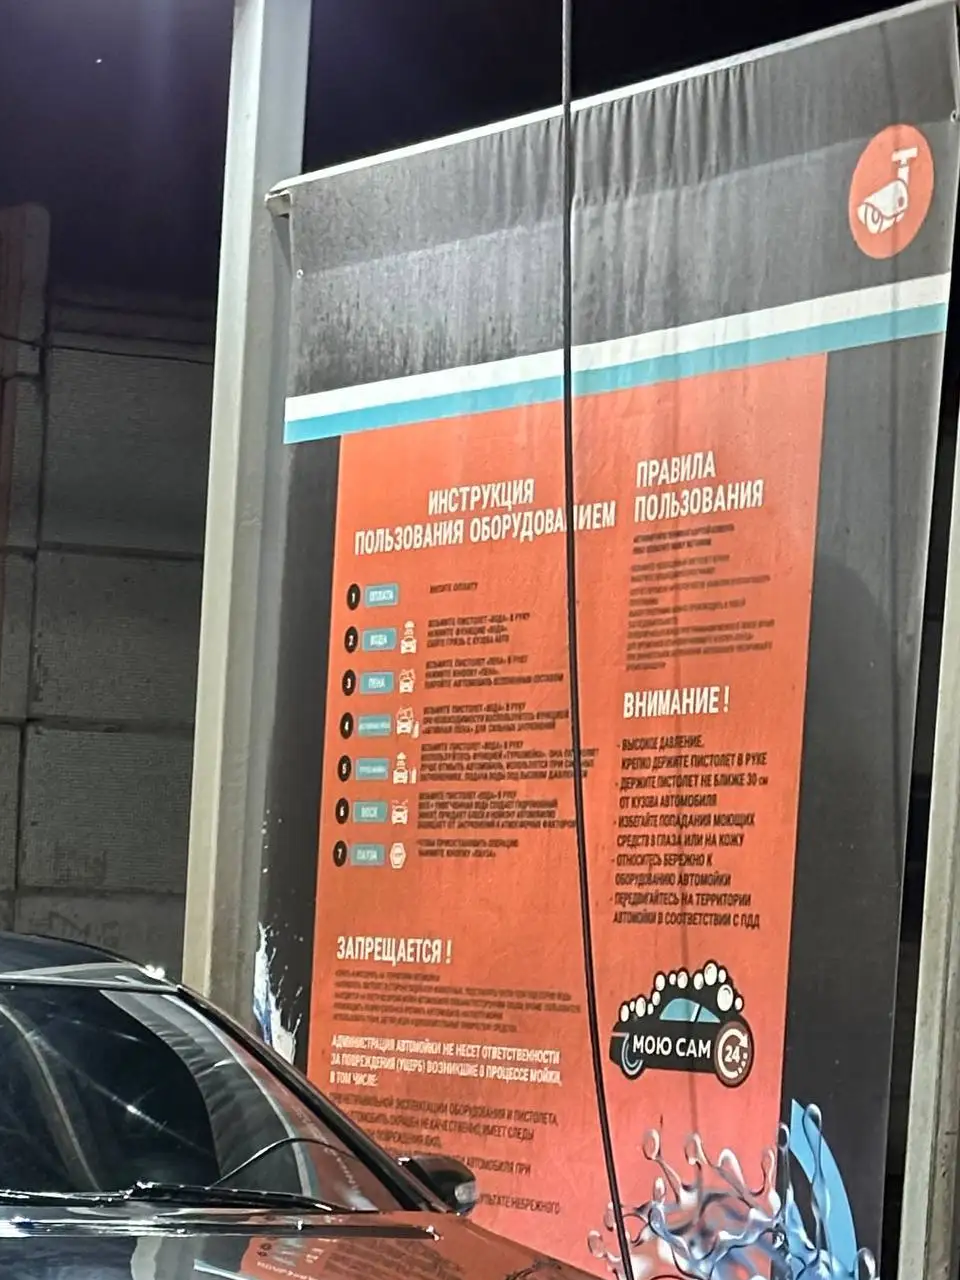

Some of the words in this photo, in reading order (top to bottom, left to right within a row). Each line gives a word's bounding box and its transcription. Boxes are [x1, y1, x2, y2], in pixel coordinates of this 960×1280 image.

[636, 451, 716, 489] ПРАВИЛА
[428, 478, 534, 515] ИНСТРУКЦИЯ
[633, 480, 765, 523] ПОЛЬЗОВАНИЯ
[354, 518, 465, 555] ПОЛЬЗОВАНИЯ
[623, 686, 720, 718] ВНИМАНИЕ
[342, 763, 346, 773] 5
[621, 756, 651, 769] КРЕПКО
[652, 755, 688, 771] ДЕРЖИТЕ
[690, 753, 735, 767] ПИСТОЛЕТ
[736, 753, 743, 765] В
[745, 752, 767, 765] РУКЕ
[620, 776, 655, 791] ДЕРЖИТЕ
[656, 774, 698, 788] ПИСТОЛЕТ
[701, 774, 712, 787] НЕ
[713, 773, 744, 786] БЛИЖЕ
[746, 772, 756, 785] 30
[619, 796, 629, 808] ОТ
[631, 795, 658, 807] КУЗОВА
[659, 793, 717, 807] АВТОМОБИЛЯ
[658, 814, 711, 829] ПОПАДАНИЯ
[656, 834, 682, 846] ГЛАЗА
[684, 834, 702, 846] ИЛИ
[704, 834, 717, 846] НА
[718, 833, 744, 846] КОЖУ
[337, 848, 342, 858] 7
[663, 853, 705, 866] БЕРЕЖНО
[707, 853, 712, 865] К
[677, 871, 731, 885] АВТОМОЙКИ
[681, 893, 693, 905] НА
[695, 893, 751, 906] ТЕРРИТОРИИ
[657, 912, 662, 924] В
[664, 912, 731, 925] СООТВЕТСТВИИ
[732, 913, 738, 925] С
[740, 914, 759, 928] ПДД
[336, 935, 442, 967] ЗАПРЕЩАЕТСЯ
[442, 1043, 454, 1055] НЕ
[455, 1044, 480, 1058] НЕСЕТ
[481, 1045, 560, 1064] ОТВЕТСТВЕННОСТИ
[632, 1035, 672, 1055] МОЮ
[675, 1037, 711, 1058] САМ
[724, 1045, 740, 1062] 24
[331, 1053, 340, 1064] ЗА
[485, 1065, 528, 1085] ПРОЦЕССЕ
[336, 1071, 351, 1084] ТОМ
